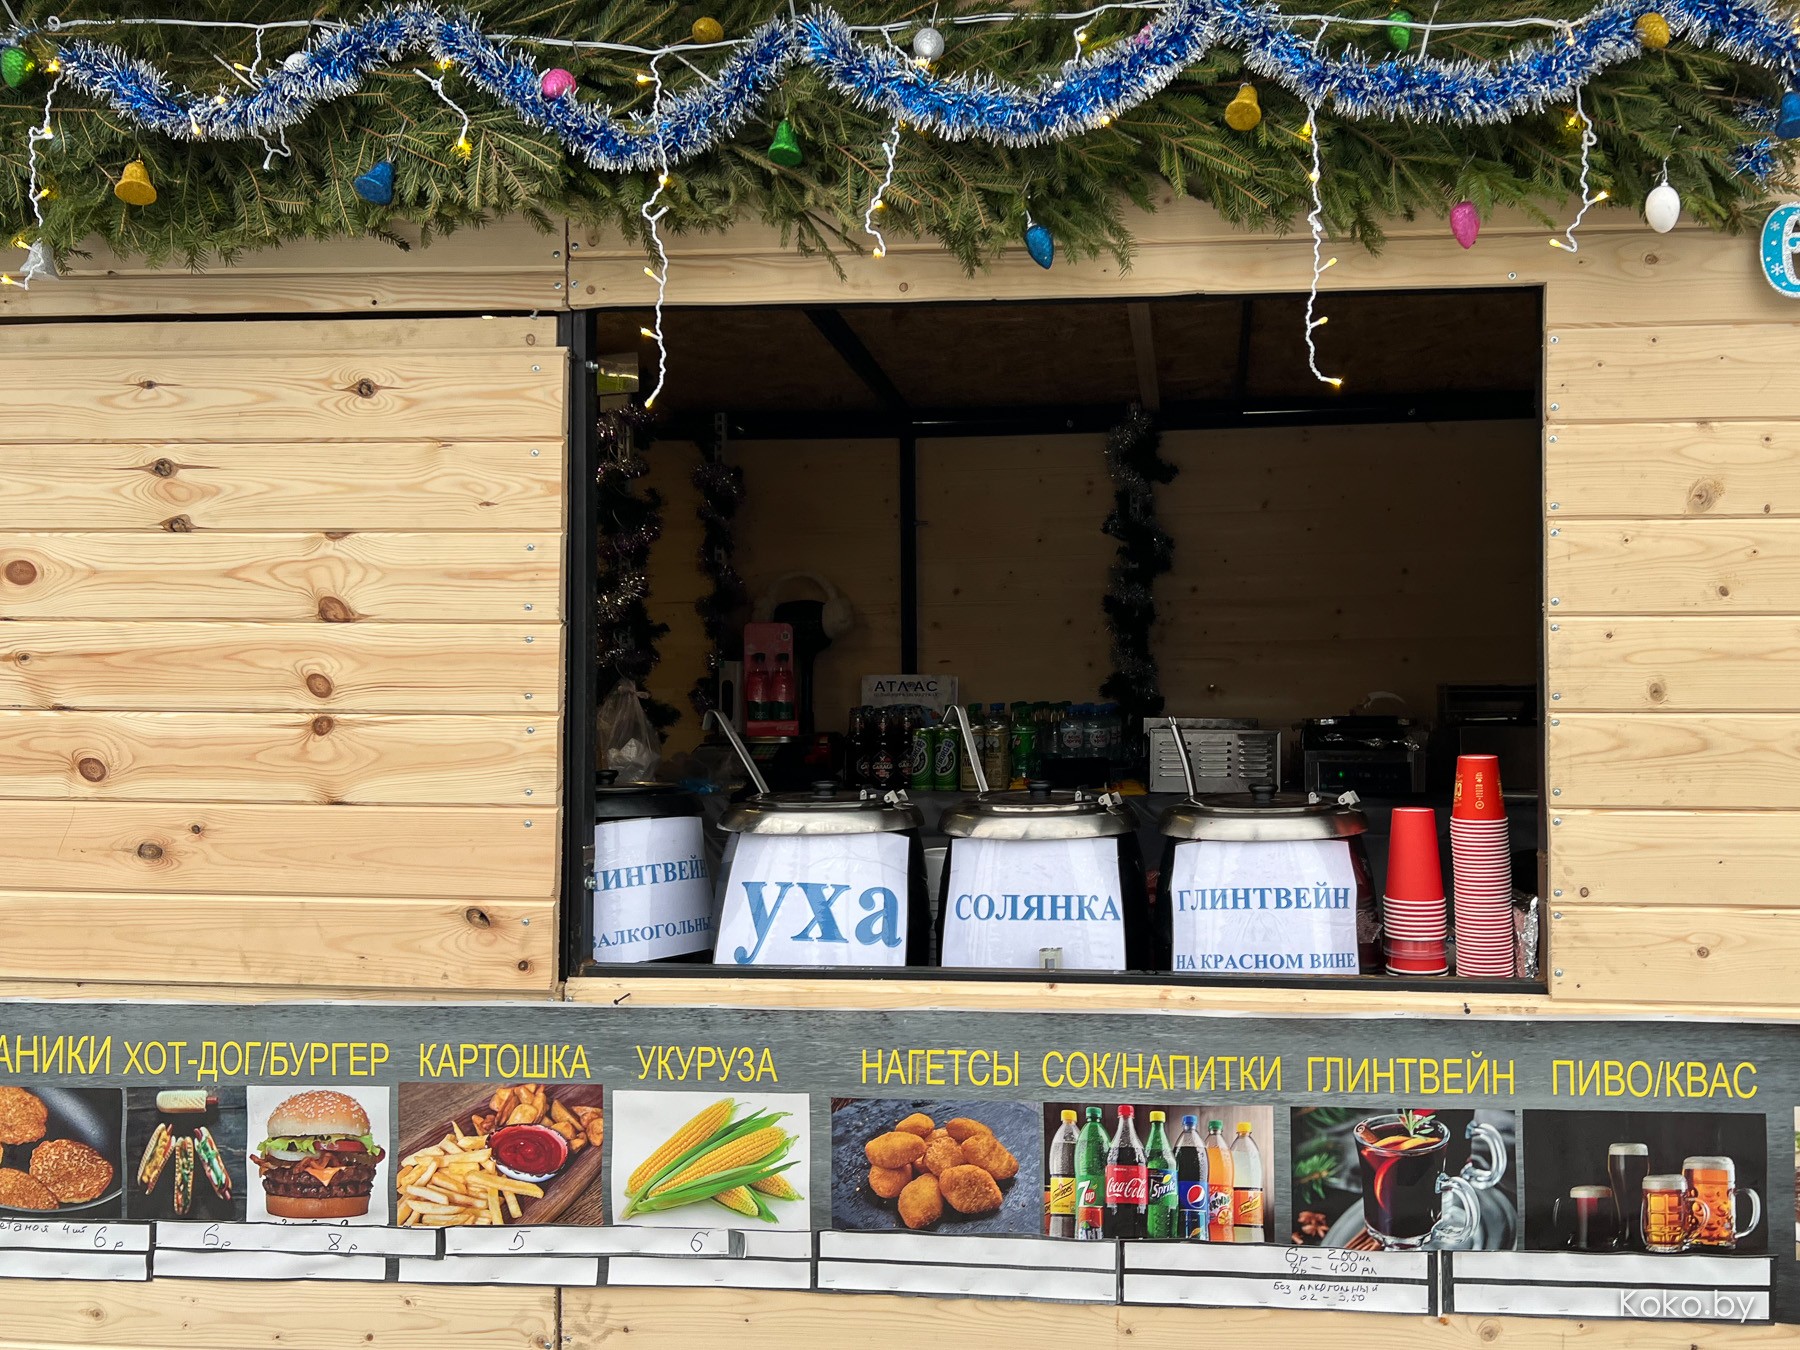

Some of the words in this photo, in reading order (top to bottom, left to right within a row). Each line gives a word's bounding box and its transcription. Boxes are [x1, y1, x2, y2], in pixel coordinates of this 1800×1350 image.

[955, 893, 1121, 921] СОЛЯНКА
[1177, 881, 1351, 912] ГЛИНТВЕЙН
[1176, 953, 1196, 970] НА
[1201, 952, 1305, 970] КРАСНОМ
[1310, 951, 1356, 969] ВИНЕ
[123, 1040, 390, 1081] ХОТ-ДОГ/БУРГЕР
[418, 1043, 591, 1078] КАРТОШКА
[635, 1045, 778, 1082] УКУРУЗА
[861, 1048, 1019, 1087] НАГЕТСЫ
[1042, 1050, 1282, 1091] СОК/НАПИТКИ
[1307, 1050, 1515, 1096] ГЛИНТВЕЙН
[1552, 1058, 1758, 1099] ПИВО/КВАС
[1151, 1181, 1176, 1198] Sprite
[509, 1230, 530, 1251] 5
[690, 1231, 710, 1252] 6
